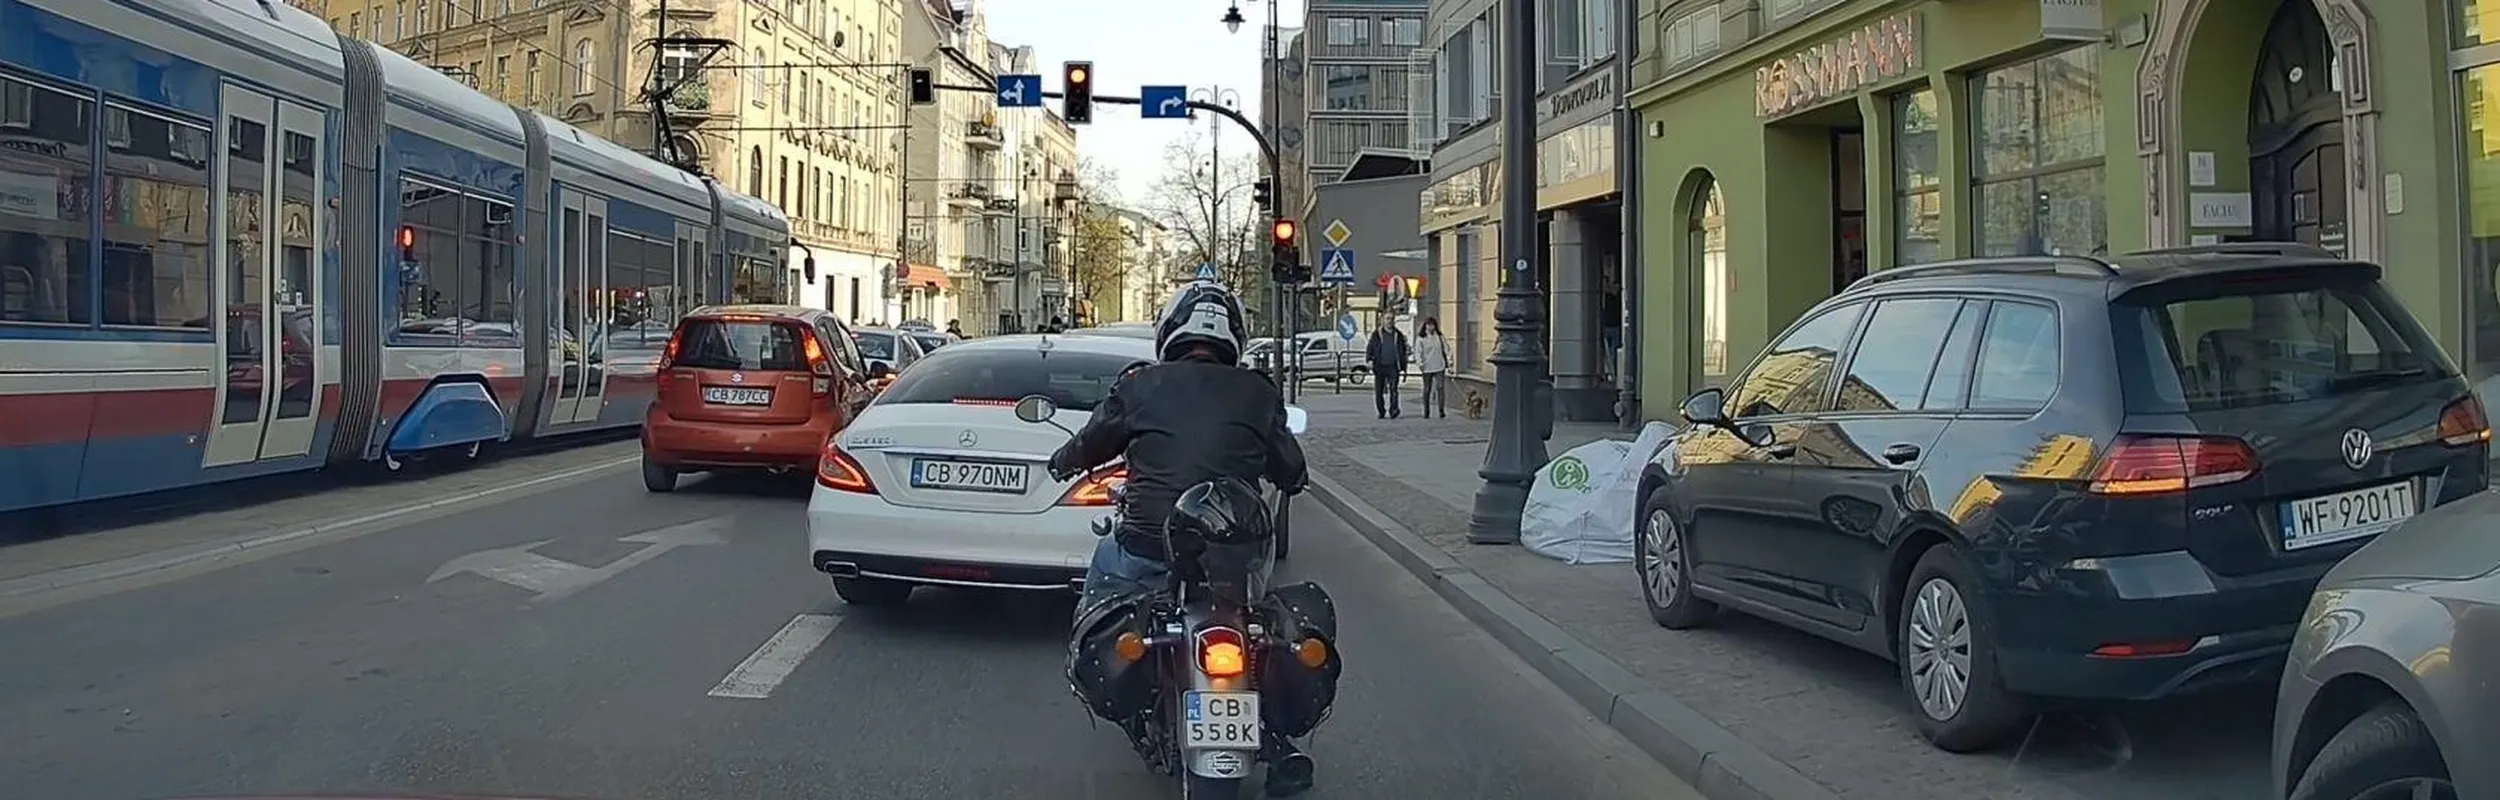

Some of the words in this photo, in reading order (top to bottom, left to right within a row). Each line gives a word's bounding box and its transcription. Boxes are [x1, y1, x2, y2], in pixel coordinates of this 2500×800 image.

[712, 389, 728, 400] CB
[731, 390, 767, 402] 787CC
[925, 463, 950, 483] CB
[957, 464, 1021, 487] 970NM
[2299, 500, 2328, 535] WF
[2339, 486, 2407, 527] 9201T
[1209, 699, 1240, 717] CB
[1191, 723, 1254, 742] 558K
